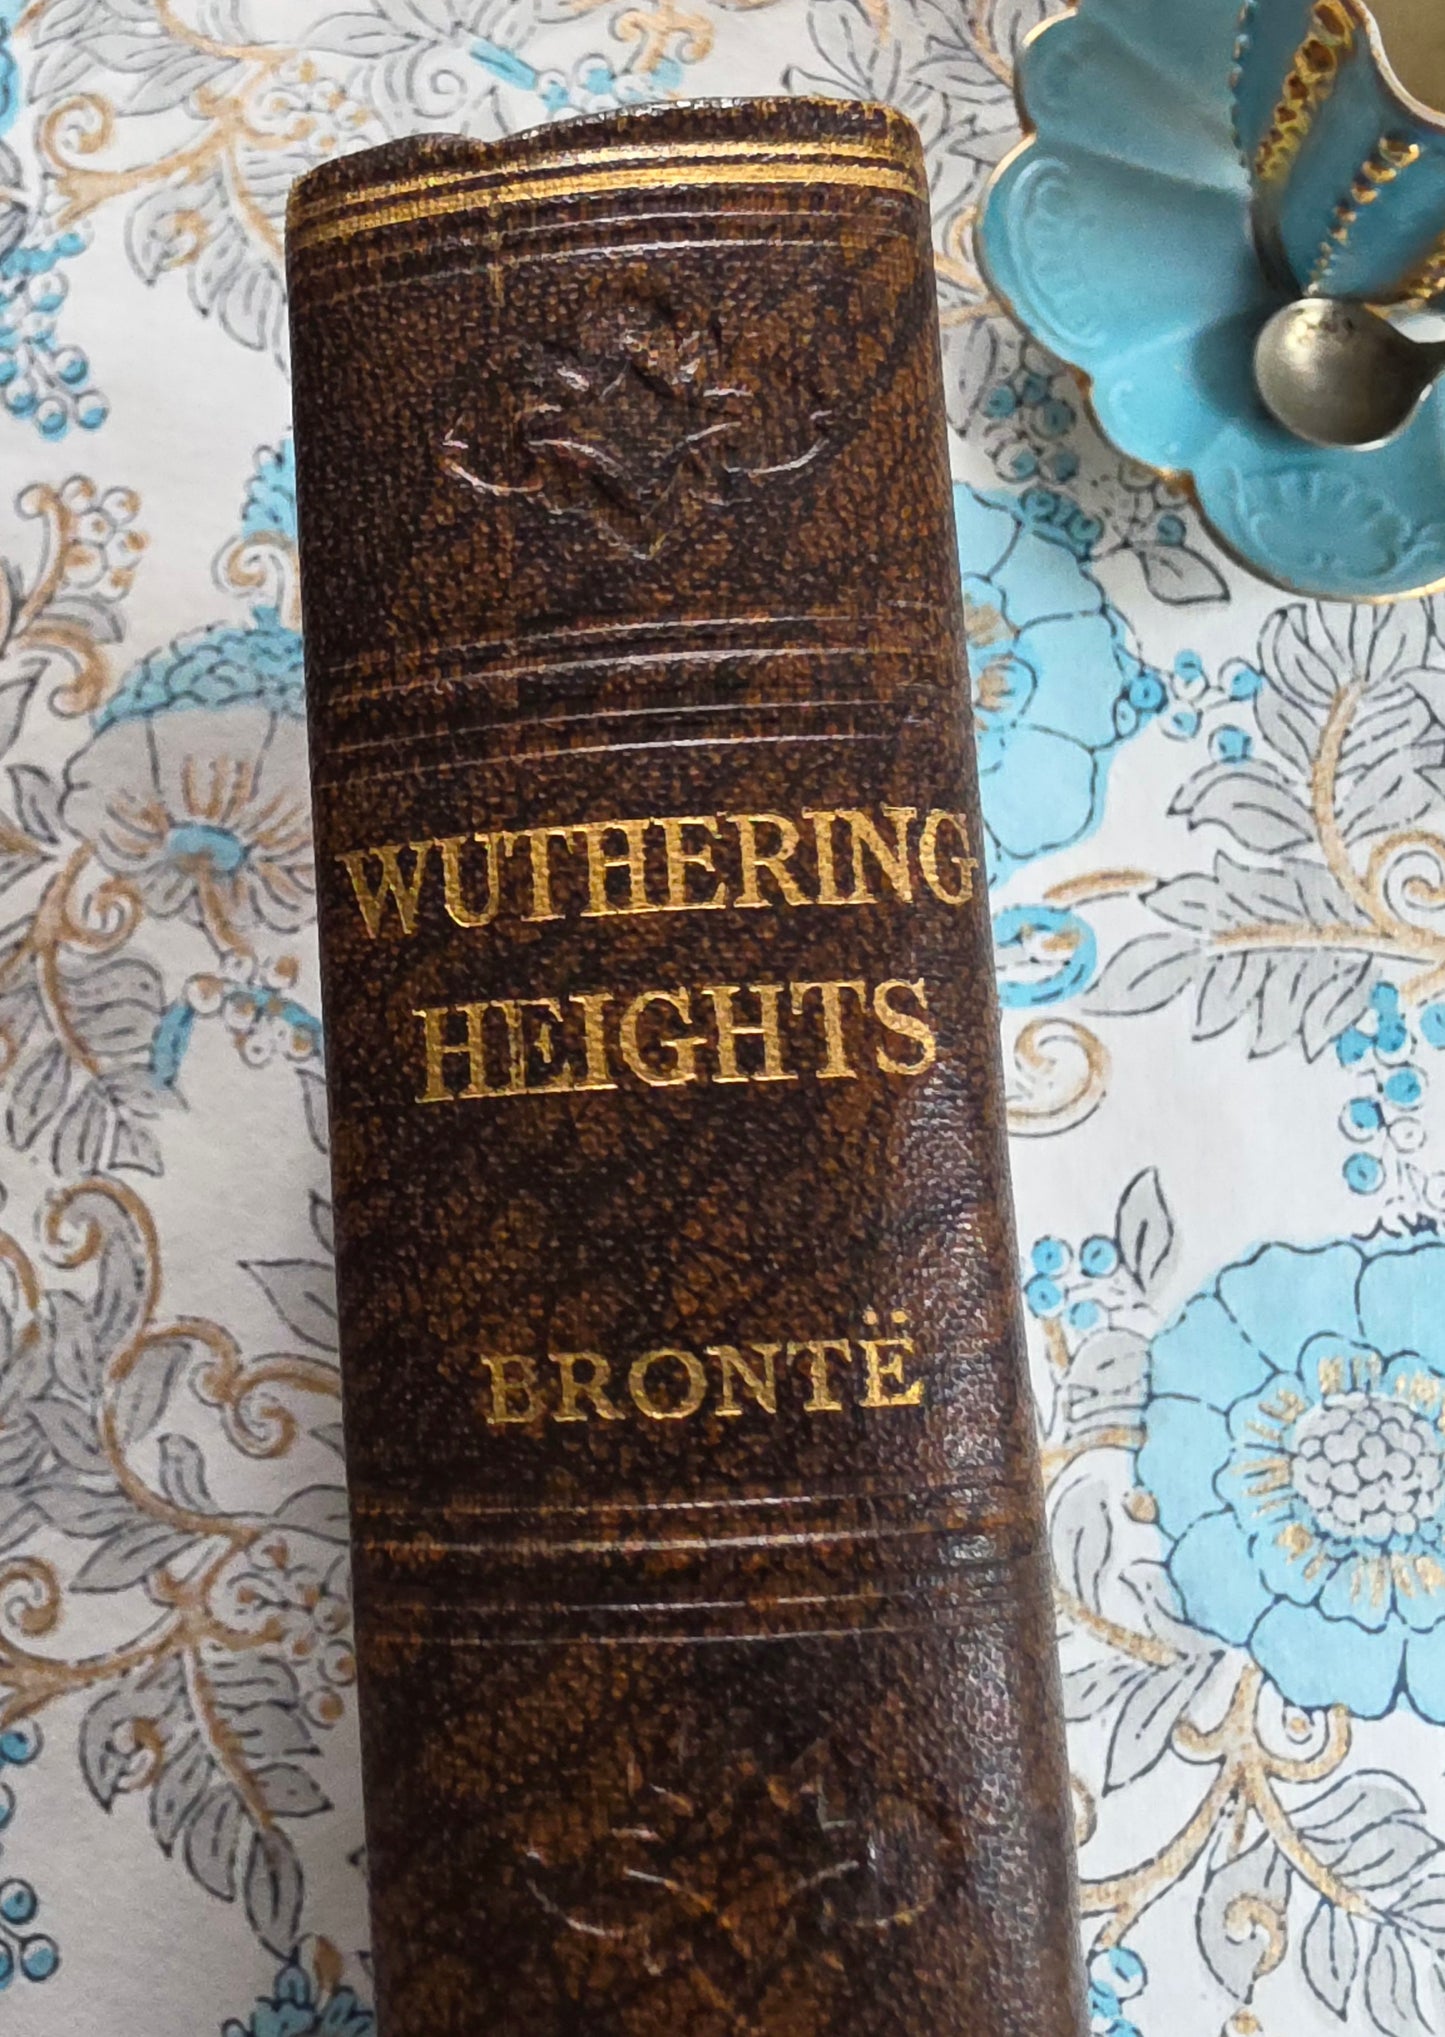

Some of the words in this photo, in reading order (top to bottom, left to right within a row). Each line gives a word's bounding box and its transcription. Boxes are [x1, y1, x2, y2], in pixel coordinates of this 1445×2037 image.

[335, 803, 979, 939] WUTHERING
[412, 978, 937, 1103] HEIGHTS
[480, 1310, 924, 1424] BRONTË
